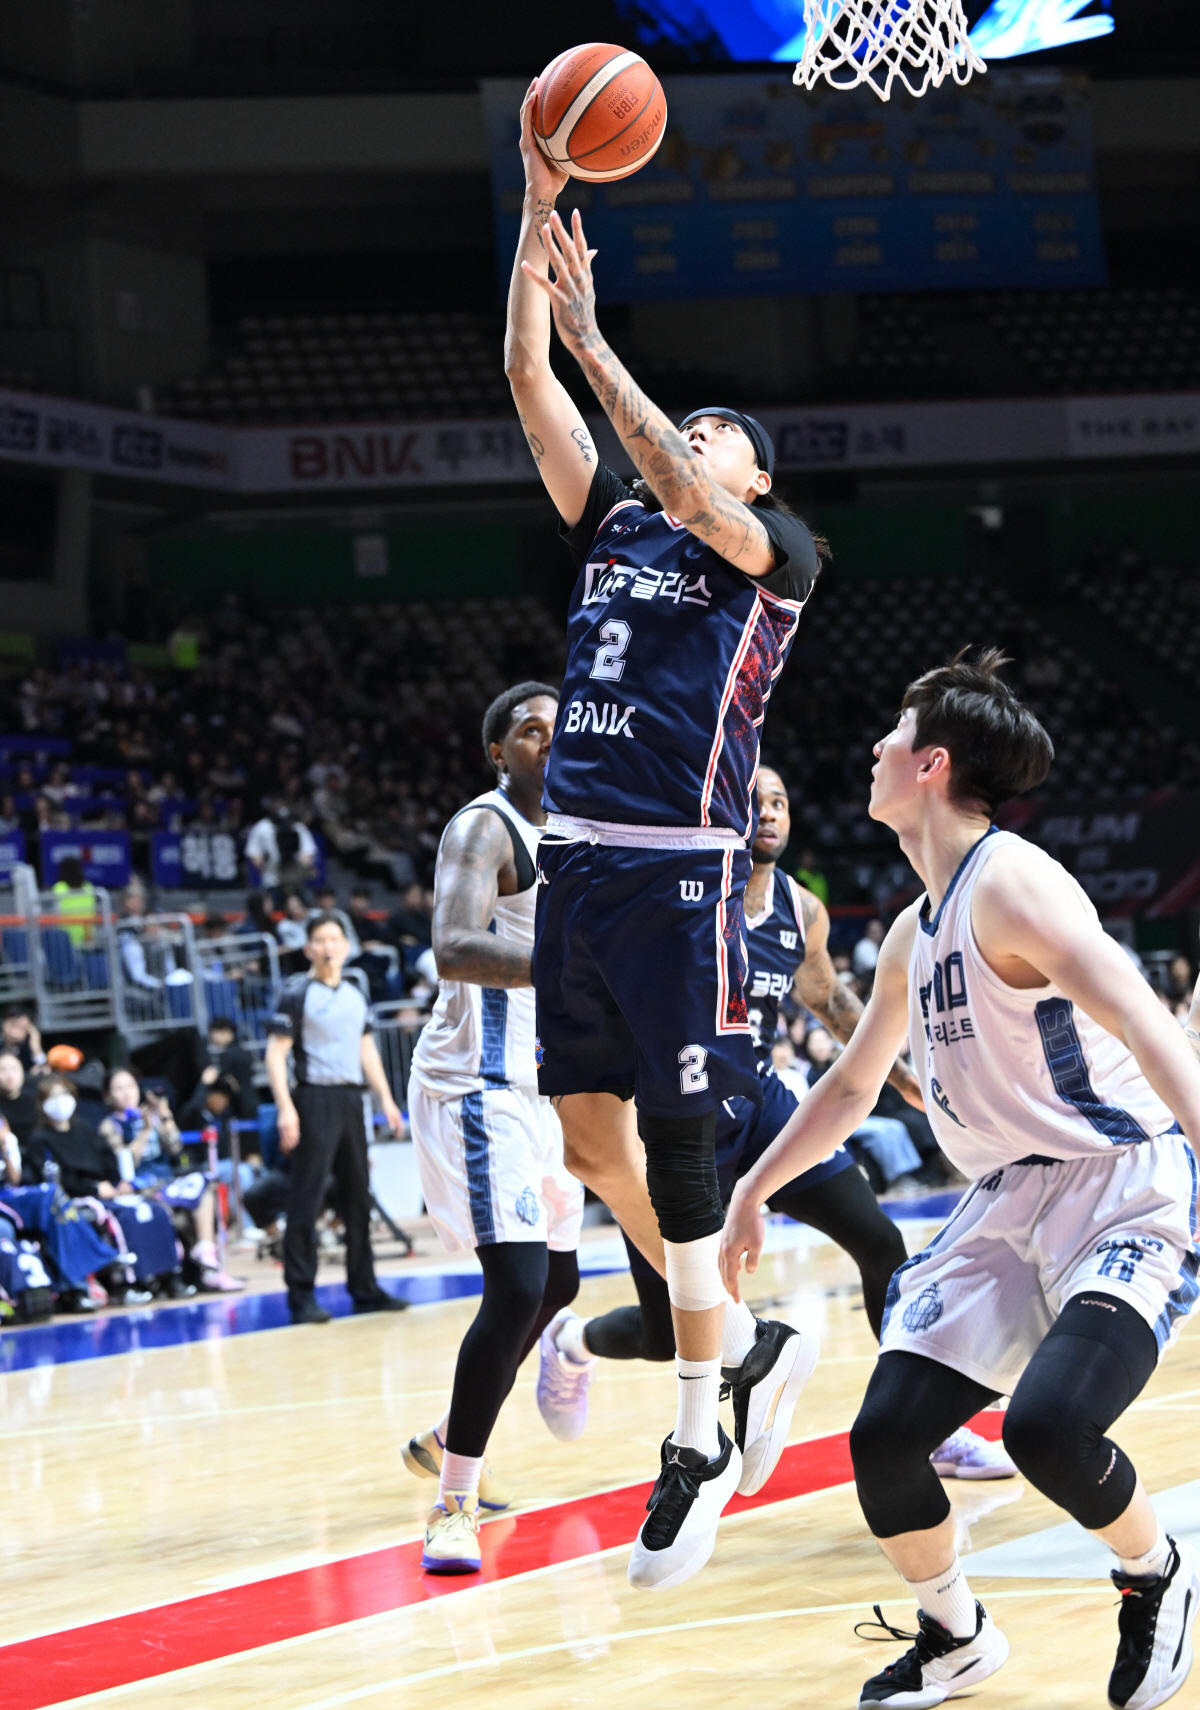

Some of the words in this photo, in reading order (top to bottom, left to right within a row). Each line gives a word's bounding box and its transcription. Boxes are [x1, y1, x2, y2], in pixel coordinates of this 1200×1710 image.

[612, 91, 640, 120] FIBA
[620, 109, 662, 156] molten
[290, 432, 423, 479] BNK
[589, 618, 632, 682] 2
[564, 700, 636, 739] BNK
[677, 1044, 709, 1095] 2
